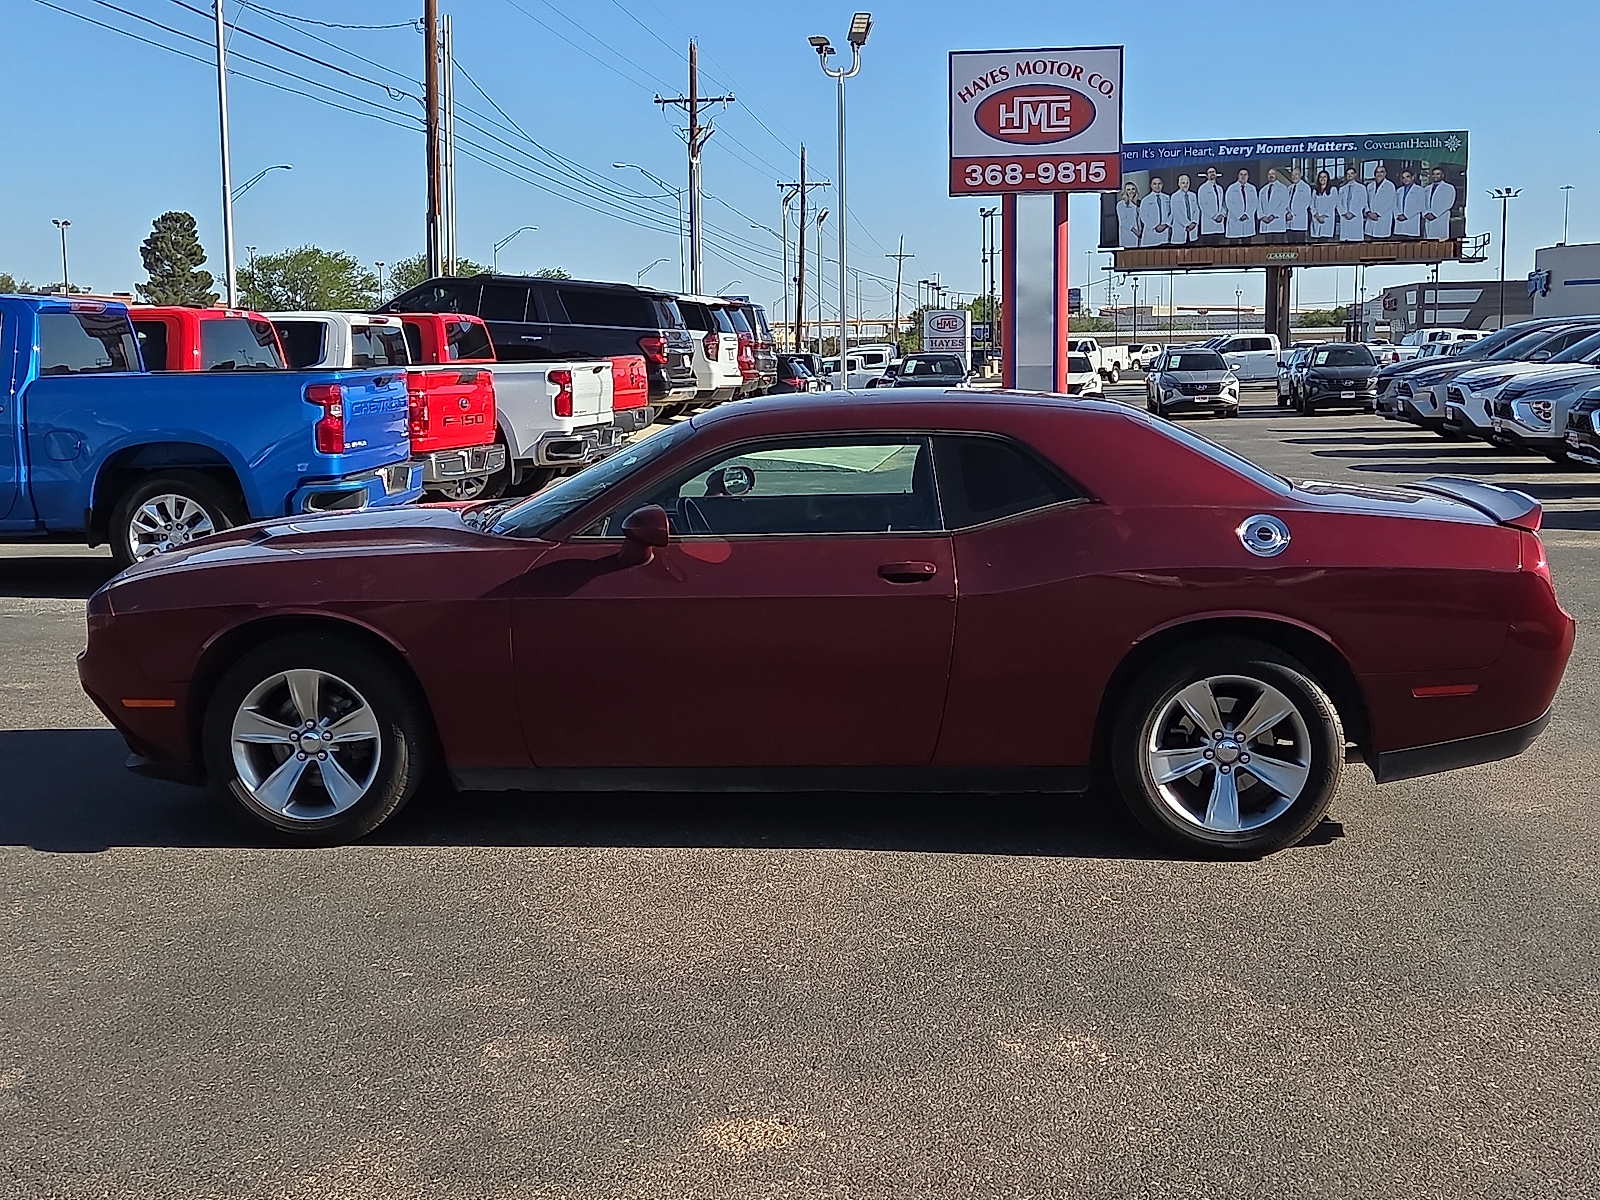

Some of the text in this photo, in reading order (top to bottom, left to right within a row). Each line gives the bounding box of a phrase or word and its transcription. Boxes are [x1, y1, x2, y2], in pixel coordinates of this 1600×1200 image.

[957, 60, 1114, 104] HAYES MOTOR CO.
[999, 94, 1071, 134] HMC
[1142, 148, 1155, 158] It's
[1158, 148, 1181, 158] Your
[1184, 146, 1215, 157] Heart,
[1218, 145, 1253, 157] Every
[1256, 143, 1304, 154] Moment
[1307, 141, 1358, 152] Matters.
[1364, 138, 1442, 150] CovenantHealth
[964, 161, 1107, 187] 368-9815
[930, 339, 964, 347] HAYES
[442, 414, 484, 428] F-150
